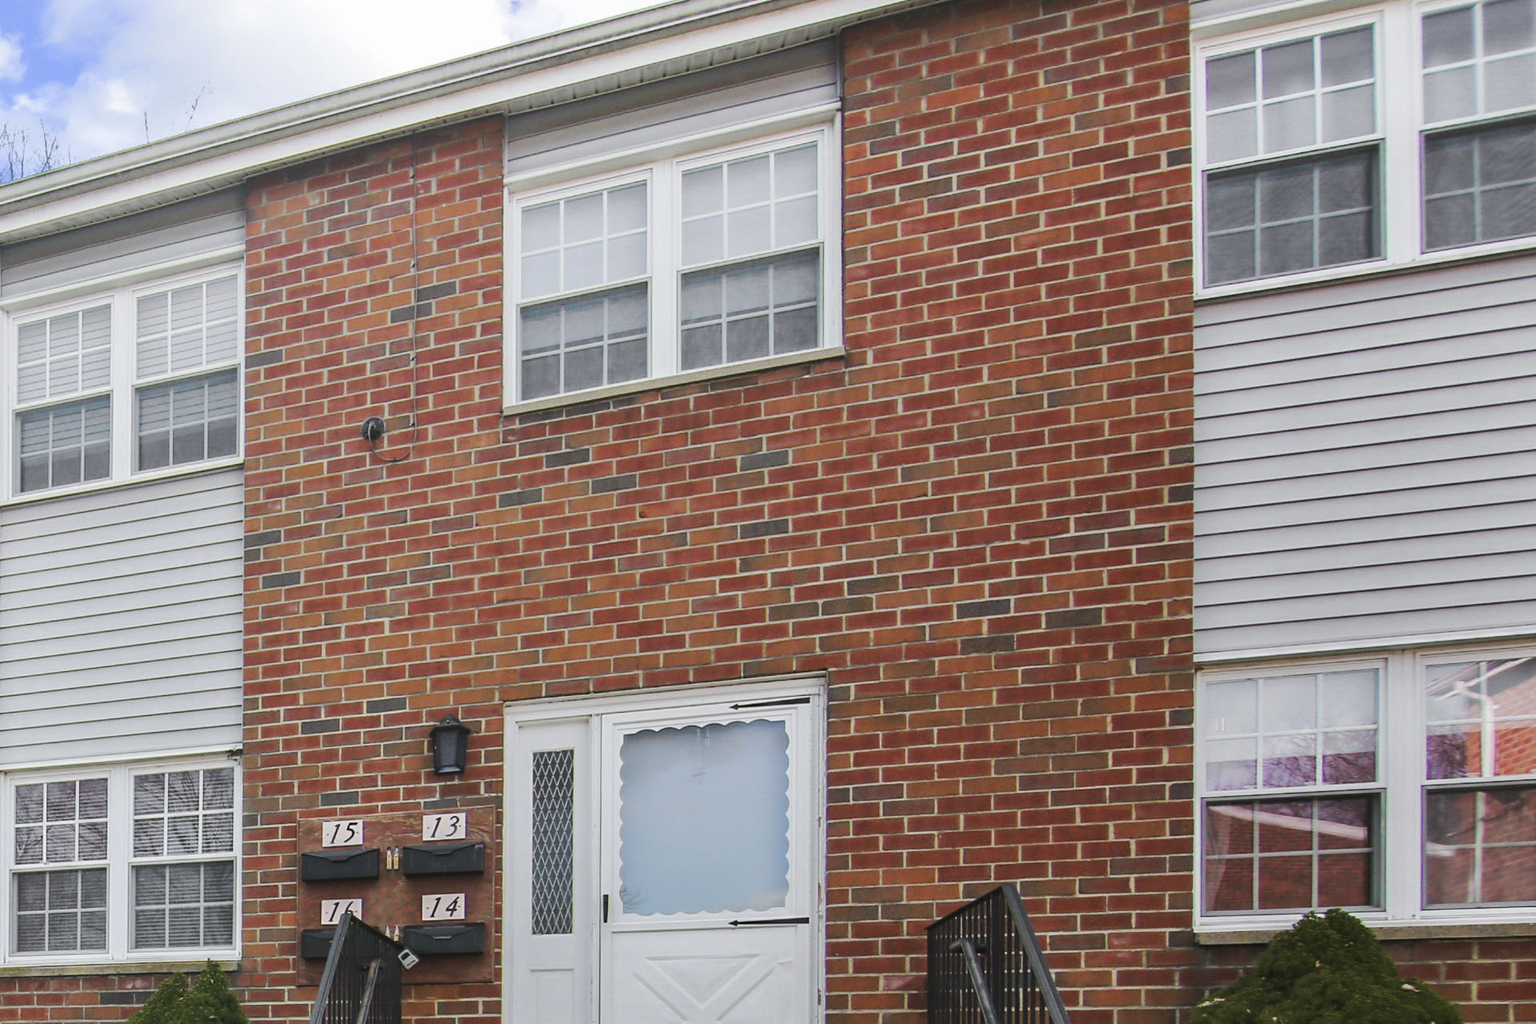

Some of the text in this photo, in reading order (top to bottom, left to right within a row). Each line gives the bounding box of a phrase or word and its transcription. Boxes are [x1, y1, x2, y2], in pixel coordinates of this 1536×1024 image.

[330, 822, 358, 844] 15
[430, 815, 460, 838] 13
[430, 896, 460, 918] 14
